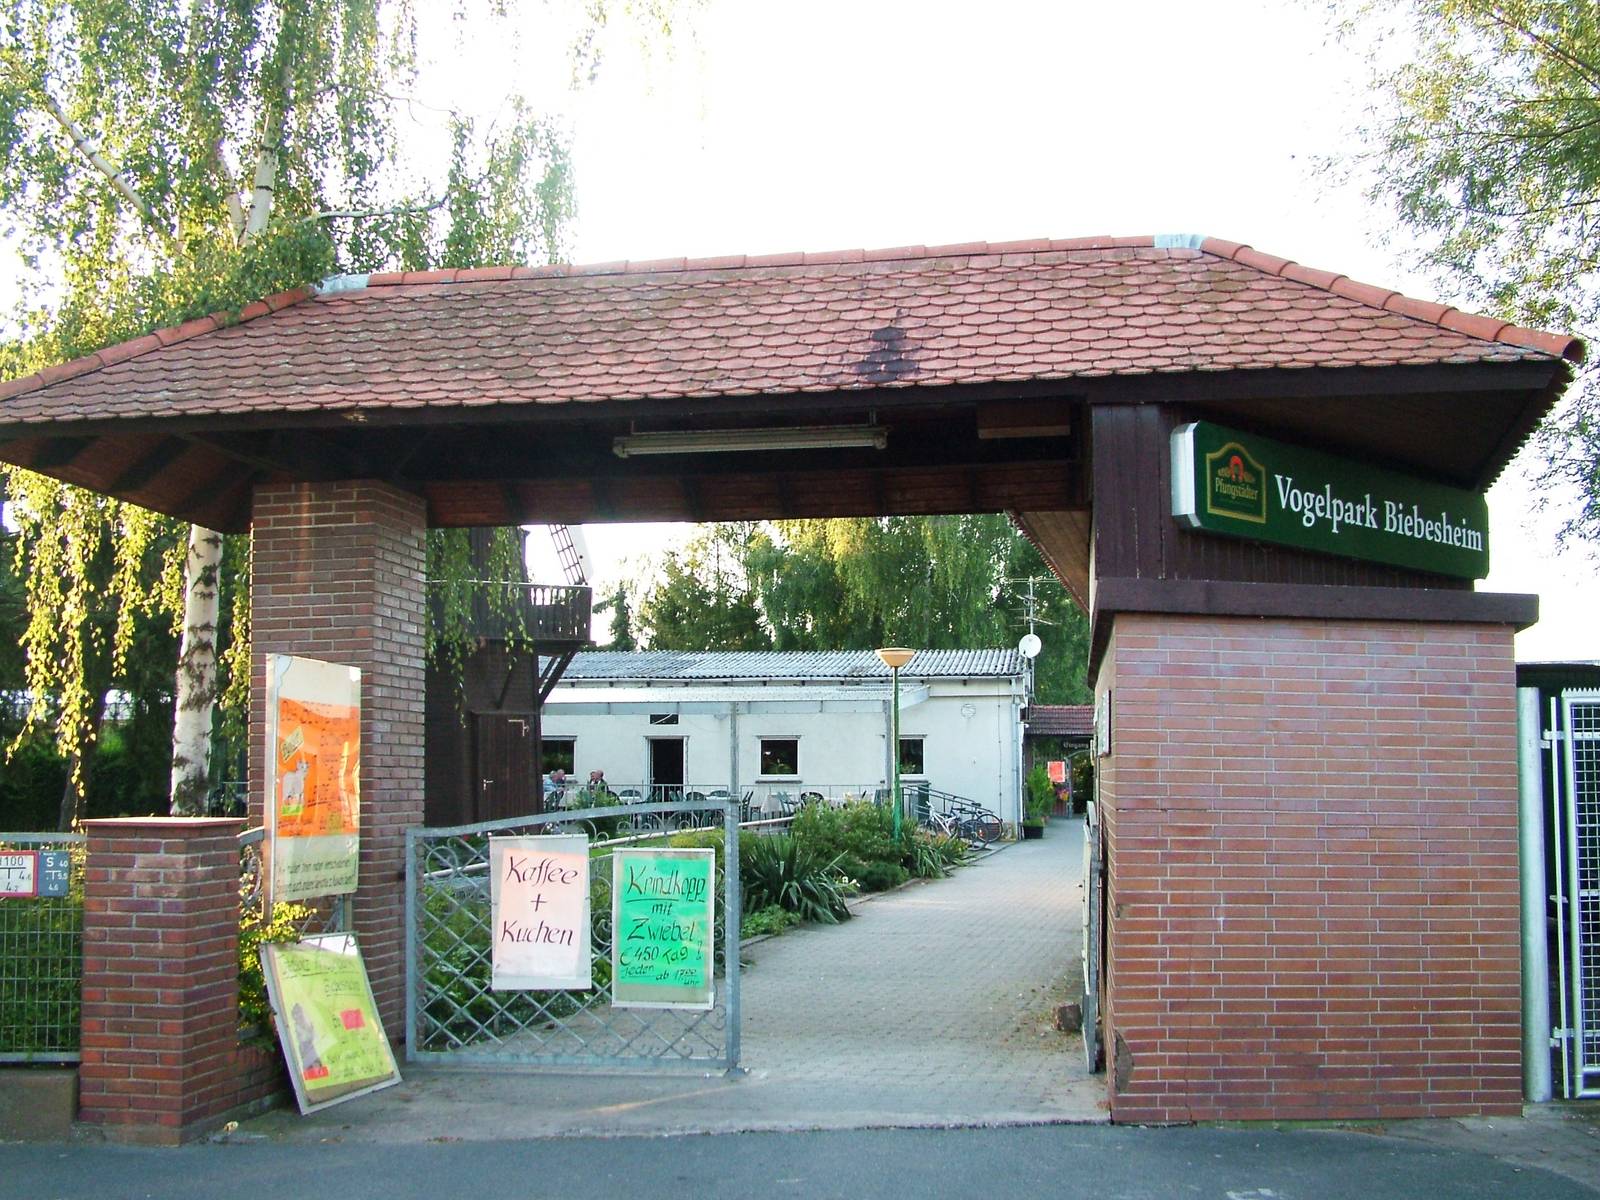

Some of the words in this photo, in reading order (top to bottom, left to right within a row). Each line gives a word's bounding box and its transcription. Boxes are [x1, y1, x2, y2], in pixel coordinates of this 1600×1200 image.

[1274, 474, 1378, 533] Vogelpark
[1384, 500, 1483, 551] Biebesheim
[505, 855, 578, 887] Kaffee
[531, 893, 547, 912] +
[651, 902, 673, 916] mit
[501, 919, 573, 946] Kuchen
[627, 917, 695, 941] Zwiebel
[662, 946, 688, 965] Tag
[656, 970, 670, 981] ab
